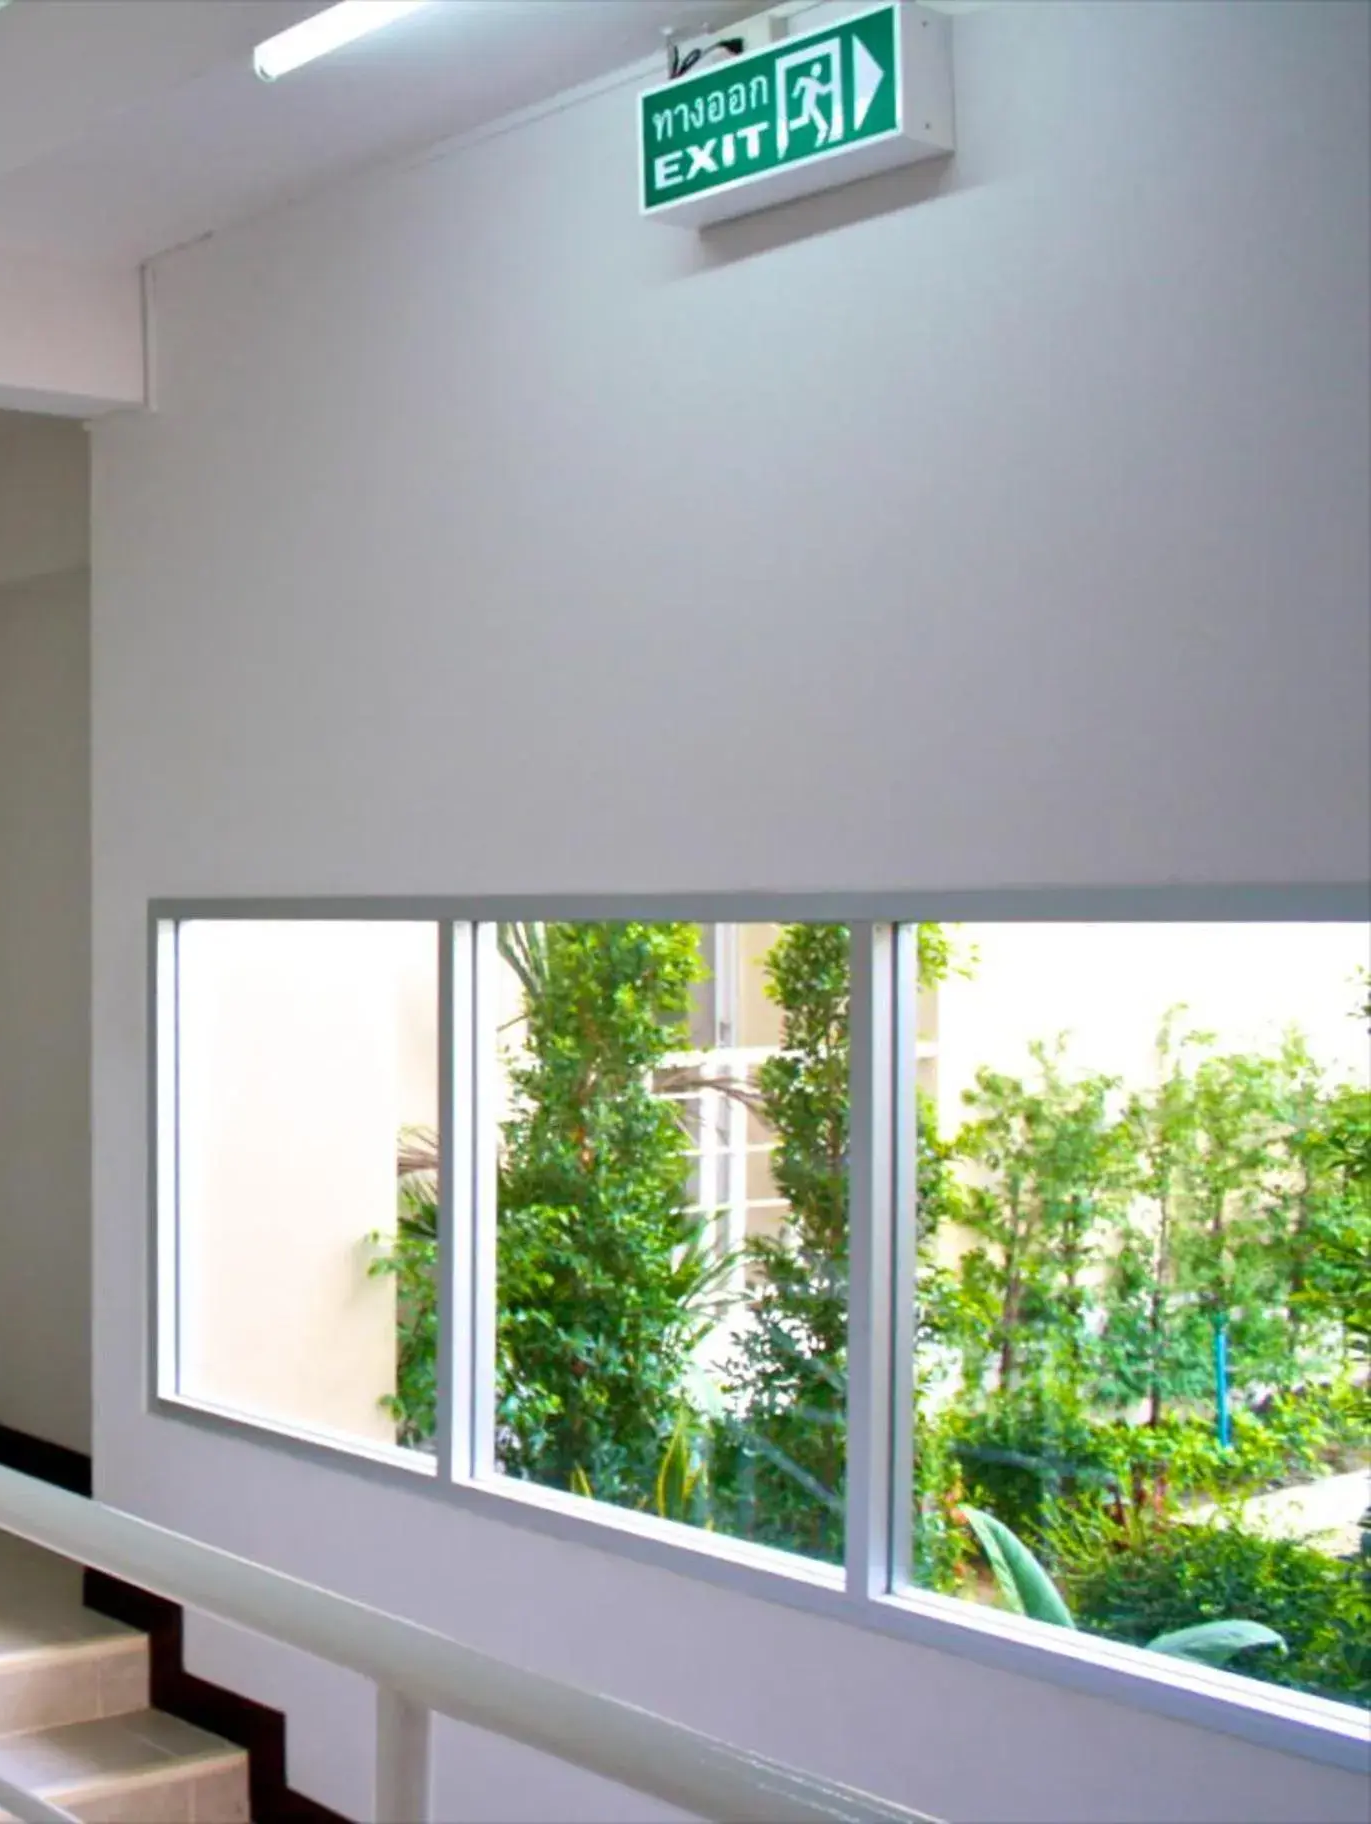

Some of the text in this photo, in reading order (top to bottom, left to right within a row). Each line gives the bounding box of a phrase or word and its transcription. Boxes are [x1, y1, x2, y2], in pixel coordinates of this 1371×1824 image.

[653, 76, 769, 141] ทางออก
[654, 122, 769, 190] EXIT
